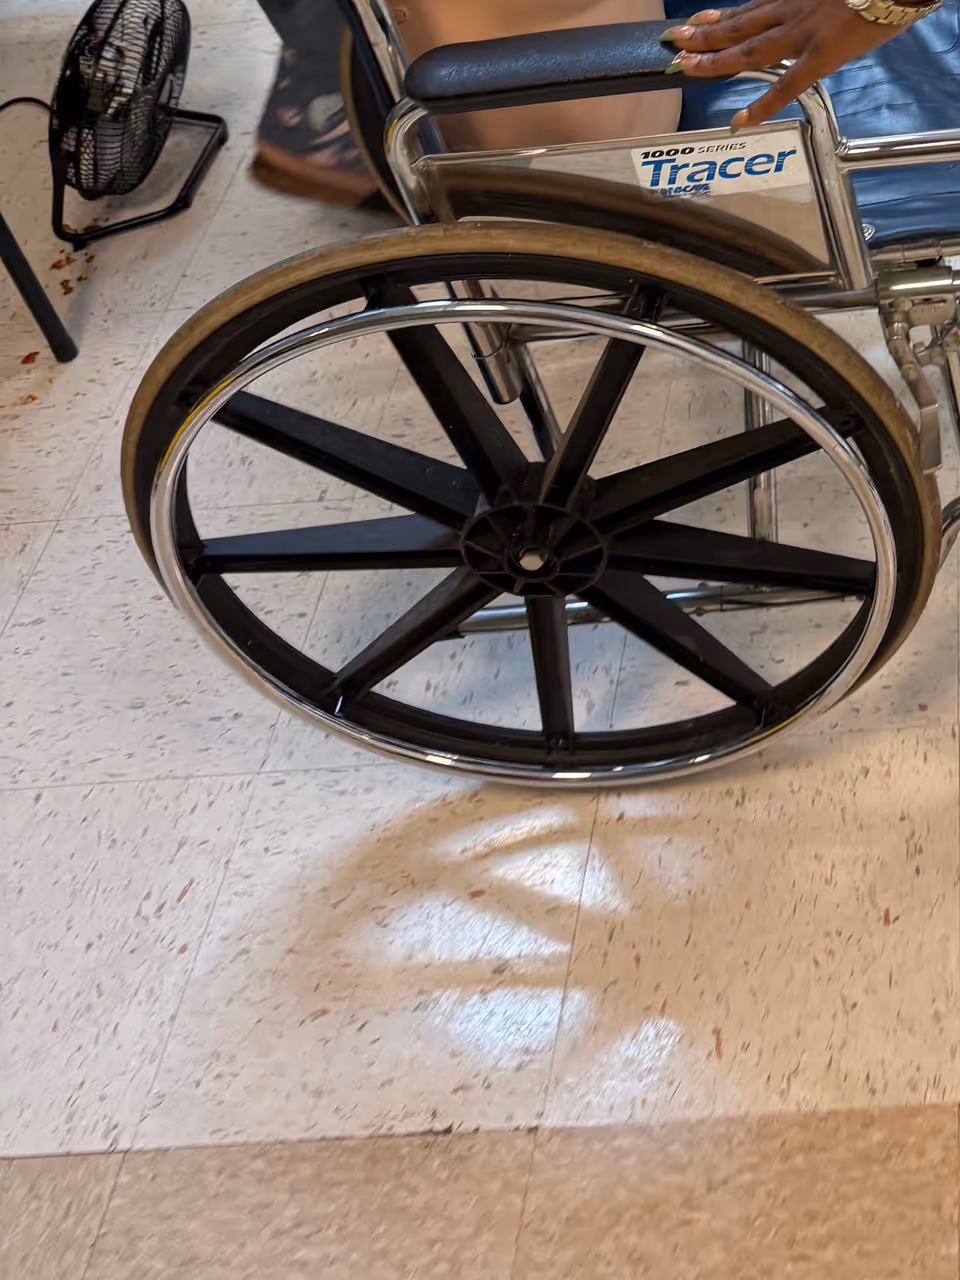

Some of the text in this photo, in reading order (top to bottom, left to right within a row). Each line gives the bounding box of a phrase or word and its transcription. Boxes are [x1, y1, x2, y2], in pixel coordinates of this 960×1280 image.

[640, 141, 747, 160] 1000 SERIES
[640, 149, 797, 188] Tracer
